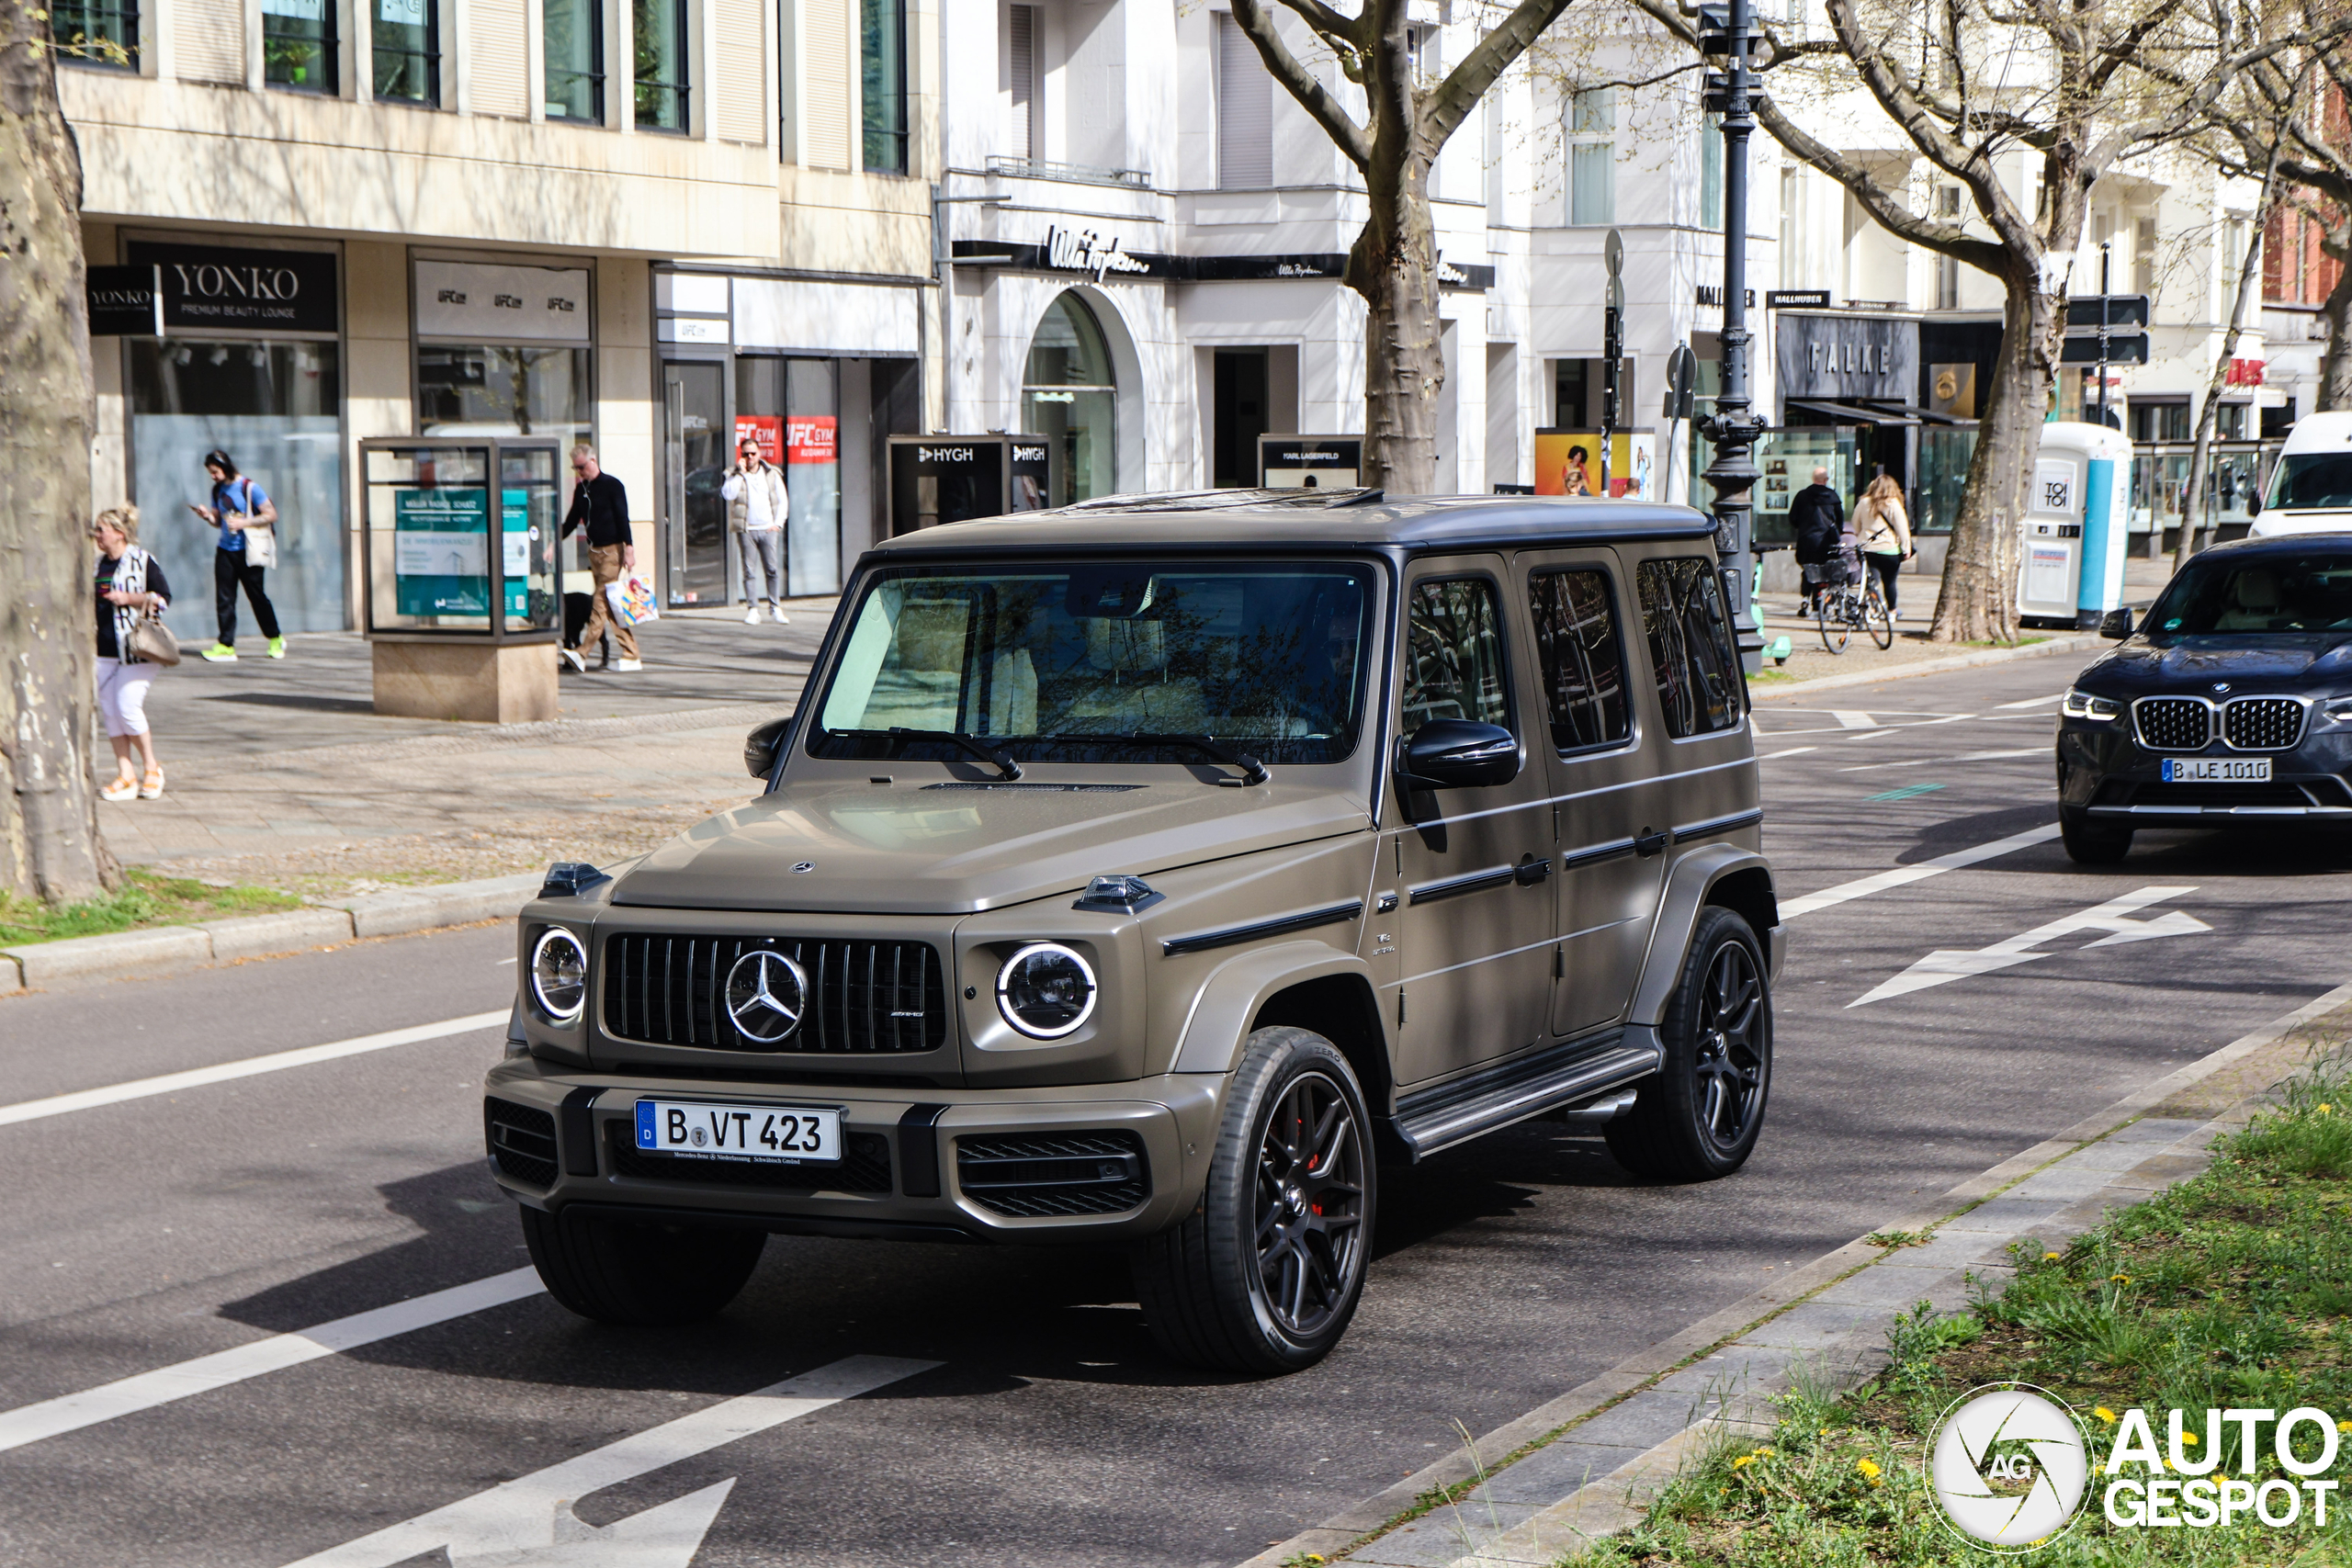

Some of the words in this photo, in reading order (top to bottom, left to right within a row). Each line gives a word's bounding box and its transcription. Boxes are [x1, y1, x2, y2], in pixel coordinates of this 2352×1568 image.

[173, 264, 299, 300] YONKO
[92, 289, 151, 305] YONKO
[1774, 294, 1823, 304] HALLHUBER
[181, 303, 220, 316] PREMIUM
[222, 305, 258, 317] BEAUTY
[261, 307, 296, 319] LOUNGE
[1809, 342, 1891, 375] FALKE
[756, 428, 775, 442] GYM
[814, 428, 834, 442] GYM
[933, 447, 974, 462] HYGH
[1022, 446, 1045, 461] HYGH
[1283, 452, 1300, 460] KARL
[1300, 452, 1340, 460] LAGERFELD
[2045, 482, 2067, 495] TOI
[2044, 494, 2067, 507] TOI
[2174, 762, 2184, 779] B
[2197, 762, 2218, 779] LE
[2223, 762, 2267, 779] 1010
[644, 1129, 652, 1140] D
[668, 1109, 688, 1144] B
[710, 1111, 752, 1148] VT
[760, 1114, 821, 1152] 423
[673, 1151, 709, 1160] Mercedes-Benz
[717, 1154, 751, 1163] Niederlassung
